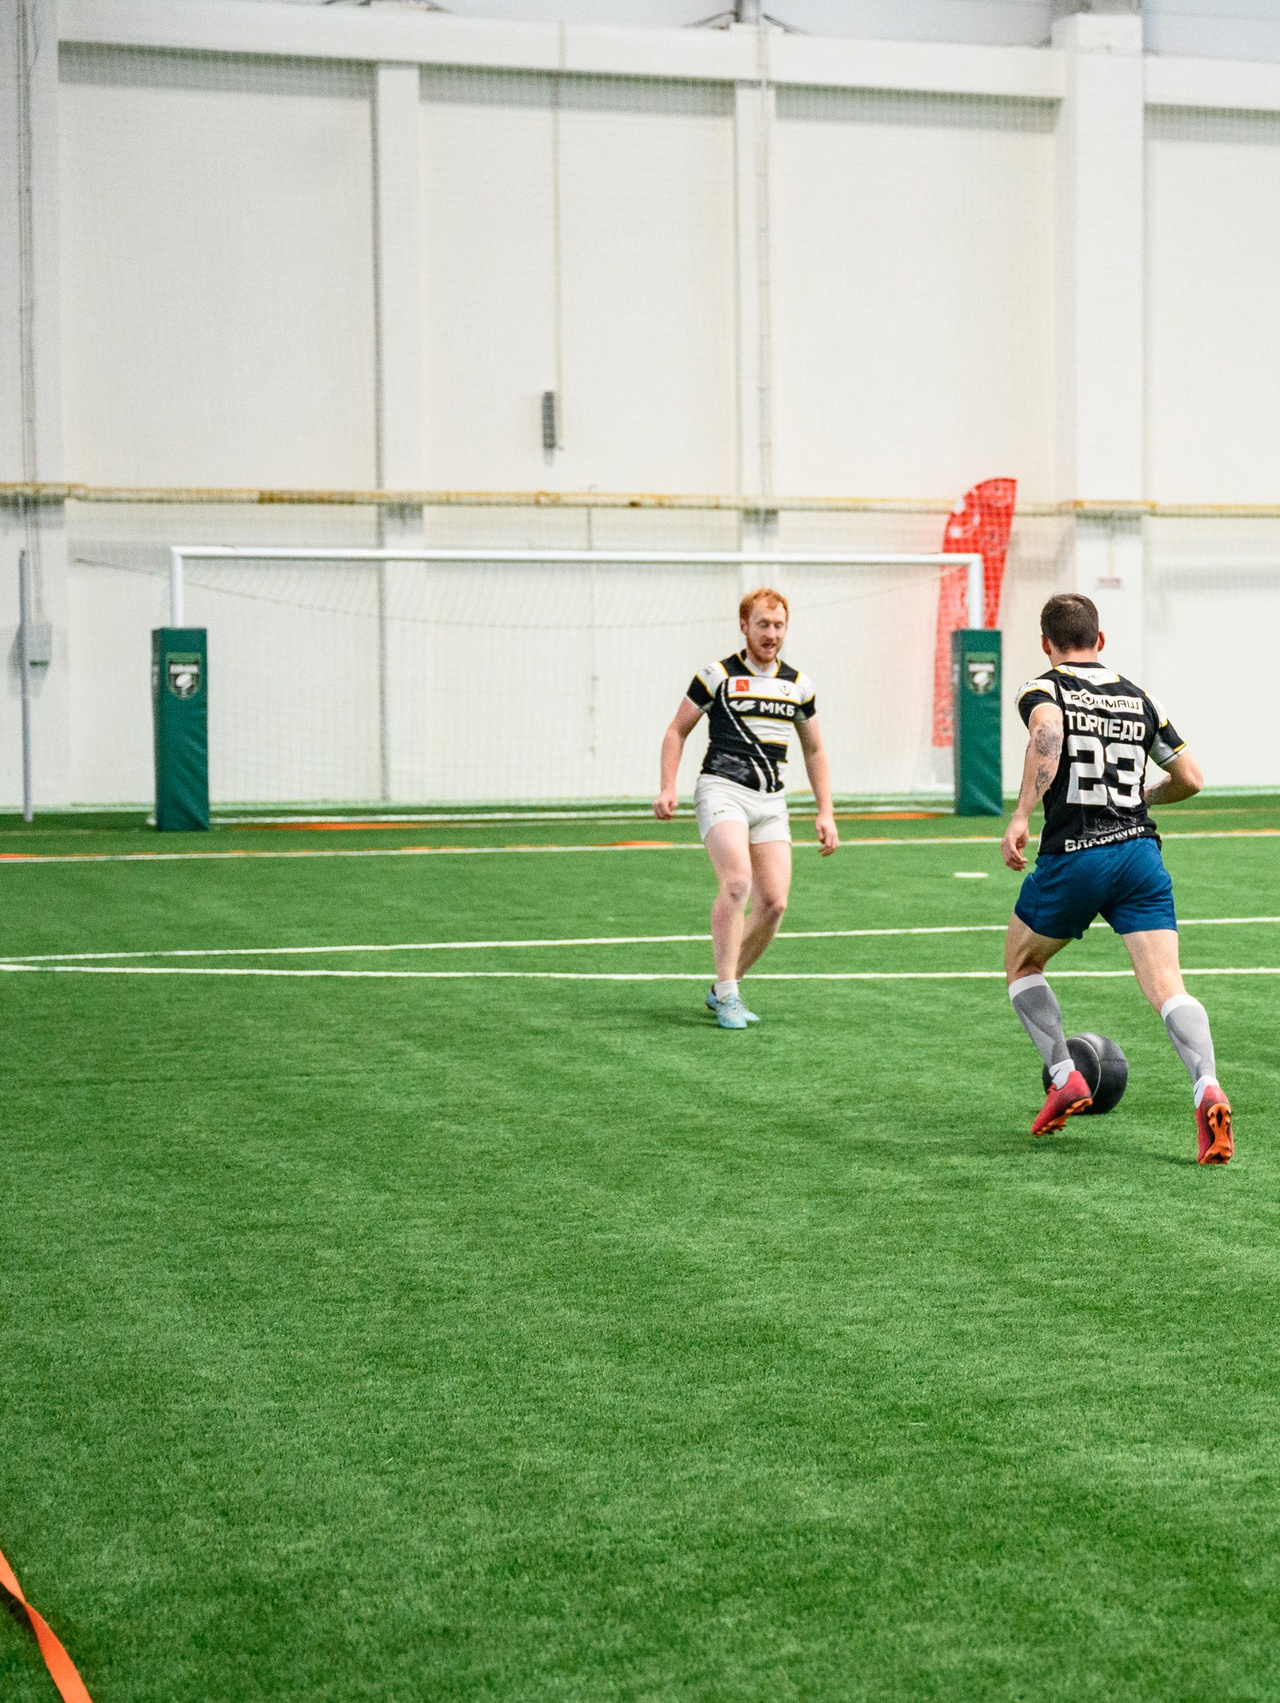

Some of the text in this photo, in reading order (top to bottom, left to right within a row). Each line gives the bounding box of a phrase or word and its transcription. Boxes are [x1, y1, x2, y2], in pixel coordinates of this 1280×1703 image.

[760, 701, 796, 717] МКБ
[1065, 710, 1146, 741] ТОРПЕДО
[1066, 734, 1146, 808] 23
